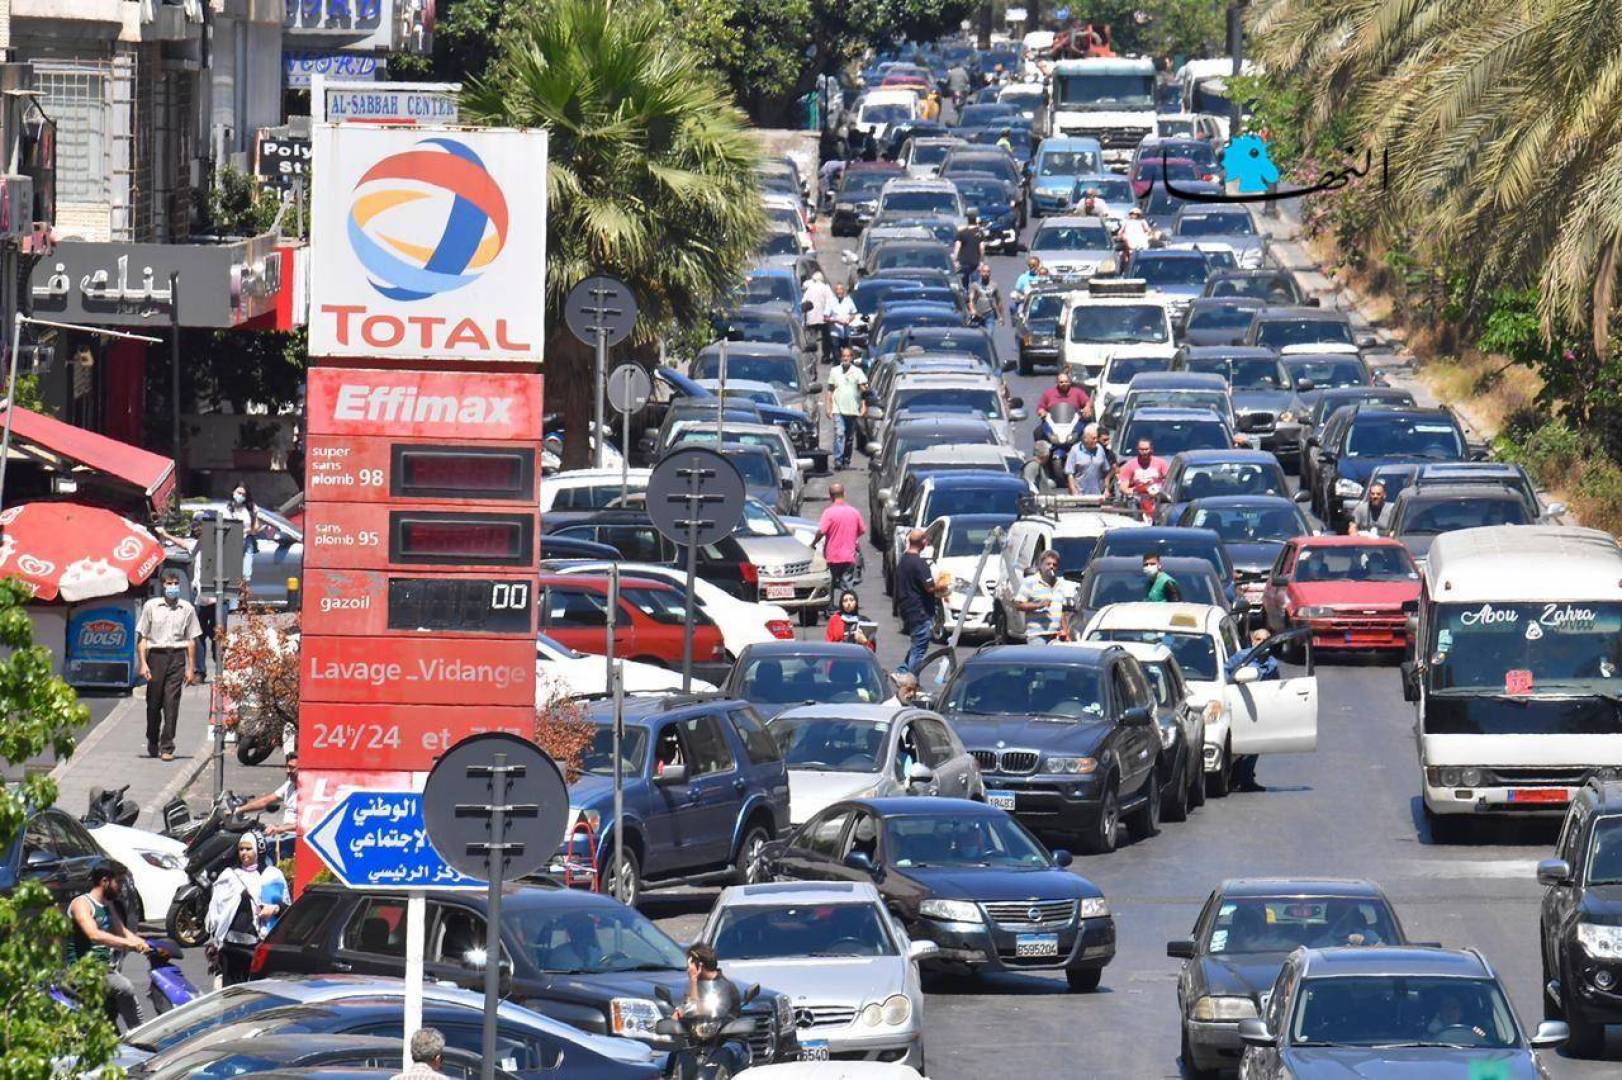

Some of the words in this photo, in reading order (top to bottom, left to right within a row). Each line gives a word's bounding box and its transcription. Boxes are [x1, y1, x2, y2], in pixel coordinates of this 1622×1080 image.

[331, 95, 399, 115] AL-SABBAH
[406, 95, 454, 116] CENTER
[321, 303, 531, 351] TOTAL
[333, 384, 512, 424] Effimax
[312, 447, 350, 458] super
[312, 461, 342, 471] sans
[312, 473, 354, 487] plomb
[359, 469, 384, 487] 98
[315, 523, 342, 534] sans
[315, 535, 354, 546] plomb
[358, 531, 380, 546] 95
[320, 596, 371, 613] gazoil
[492, 584, 528, 609] 00
[1460, 604, 1519, 626] Abou
[1540, 603, 1596, 626] Zahra
[311, 658, 403, 686] Lavage
[421, 727, 452, 750] et
[353, 798, 417, 826] الوطني
[350, 827, 433, 858] لإجتماعي
[368, 865, 429, 884] الرئيسي
[433, 864, 472, 882] ركز
